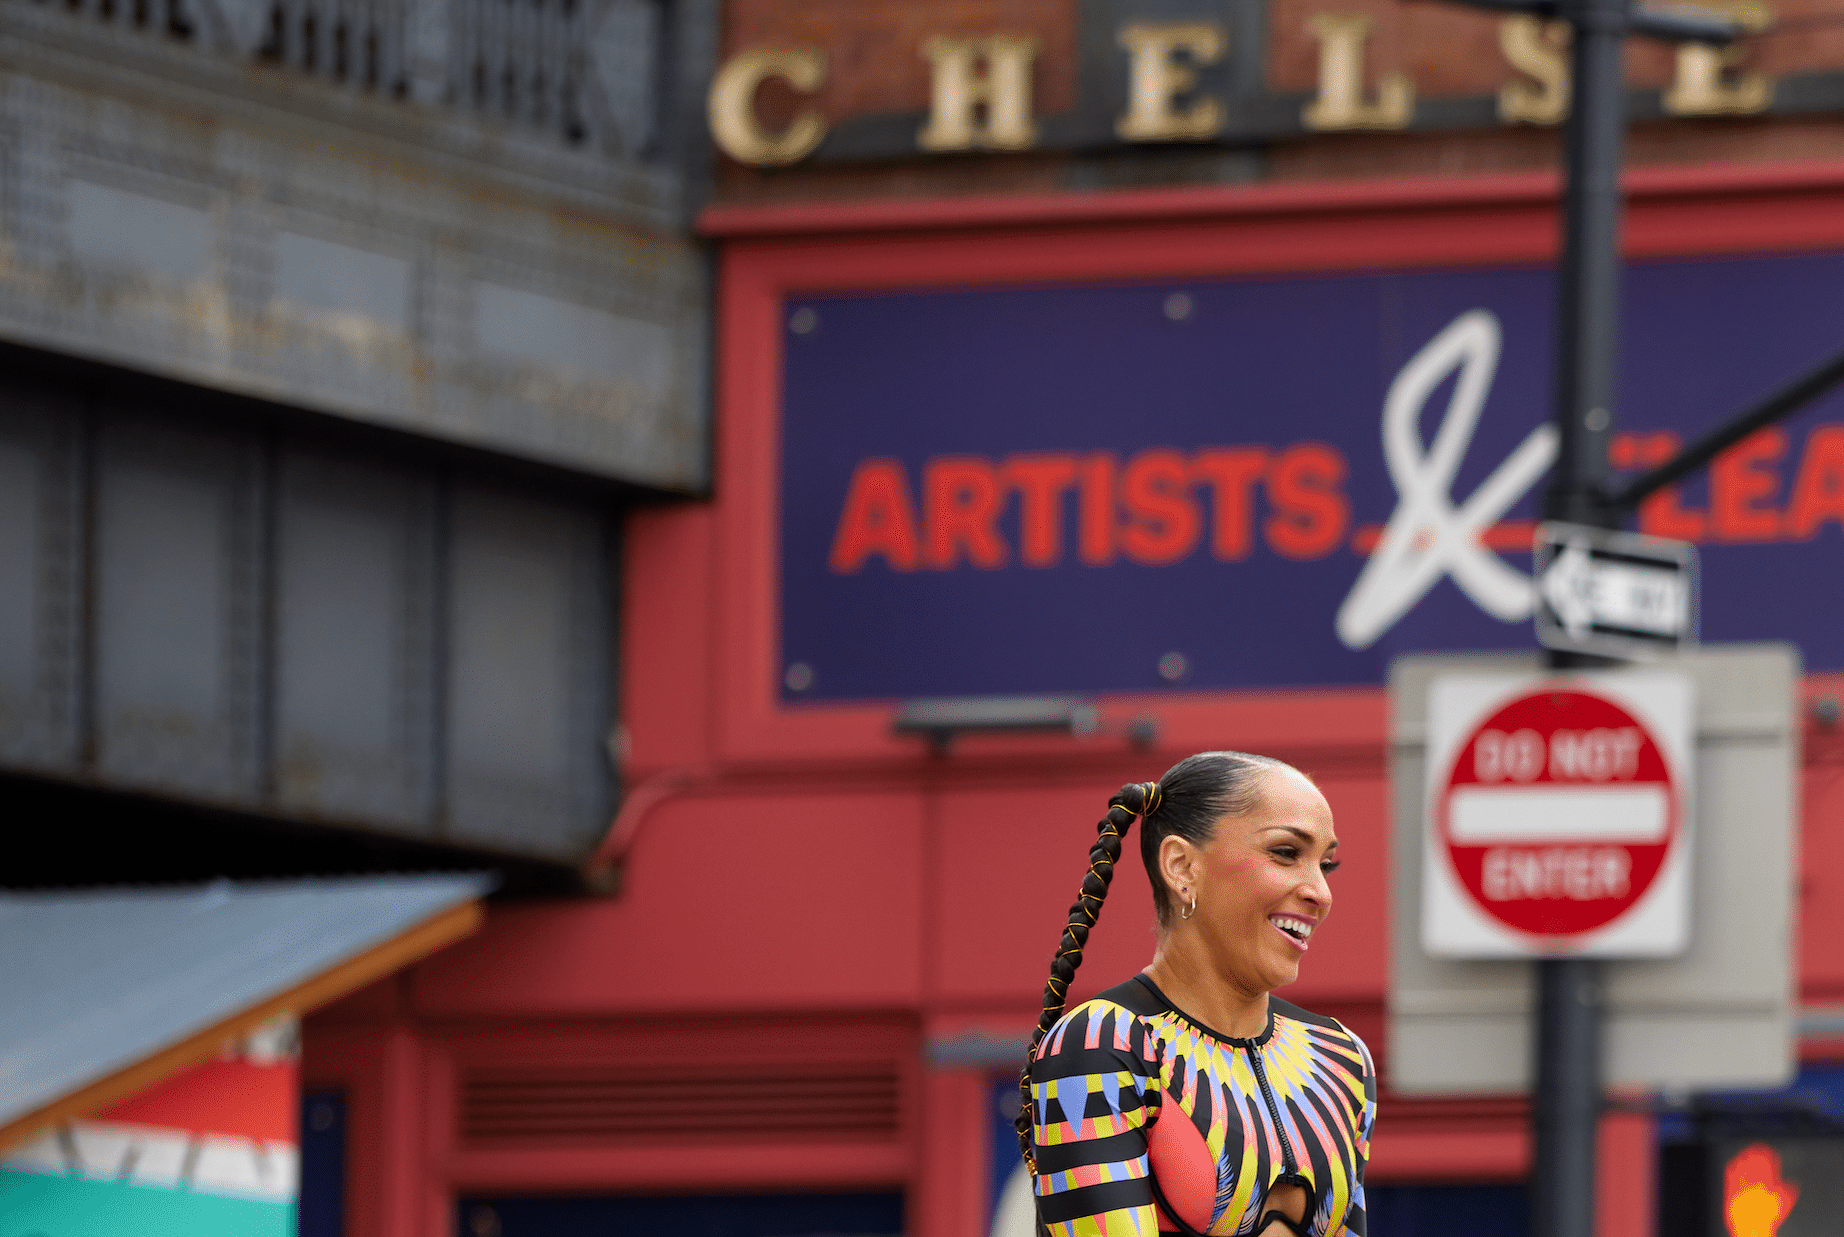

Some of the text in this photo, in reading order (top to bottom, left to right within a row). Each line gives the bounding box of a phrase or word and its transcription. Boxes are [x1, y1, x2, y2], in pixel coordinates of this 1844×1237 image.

[832, 442, 1347, 573] ARTISTS
[1475, 726, 1642, 783] DO NOT
[1482, 846, 1631, 900] ENTER
